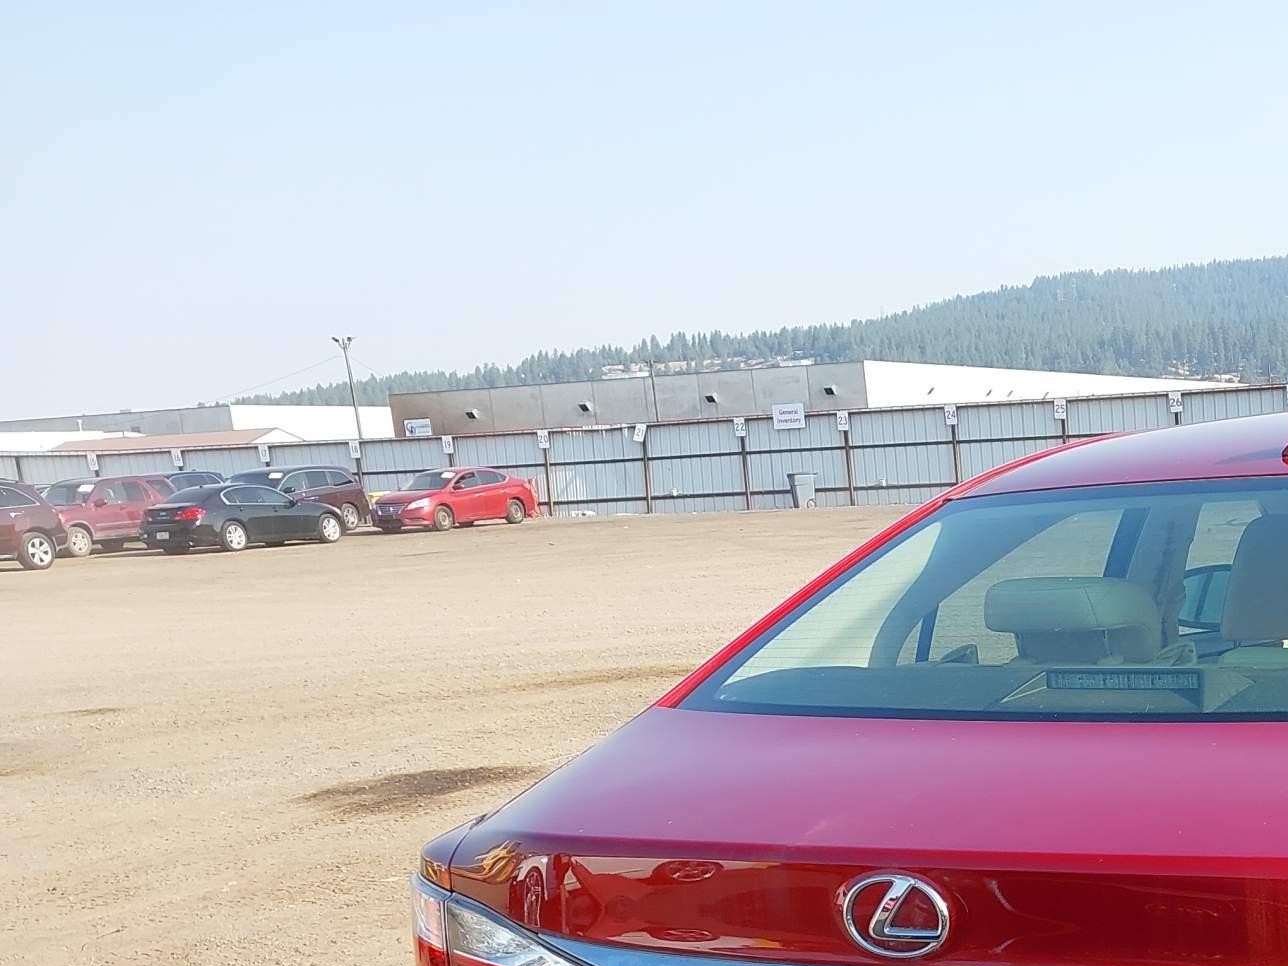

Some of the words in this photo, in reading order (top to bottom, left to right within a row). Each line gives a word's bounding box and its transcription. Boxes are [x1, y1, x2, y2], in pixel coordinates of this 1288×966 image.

[1169, 397, 1183, 408] 26
[778, 407, 799, 415] General
[1055, 404, 1066, 414] 25
[945, 410, 956, 420] 24
[838, 416, 848, 426] 23
[635, 427, 645, 437] 21
[735, 422, 746, 432] 22
[443, 439, 452, 449] 19
[538, 434, 549, 444] 20
